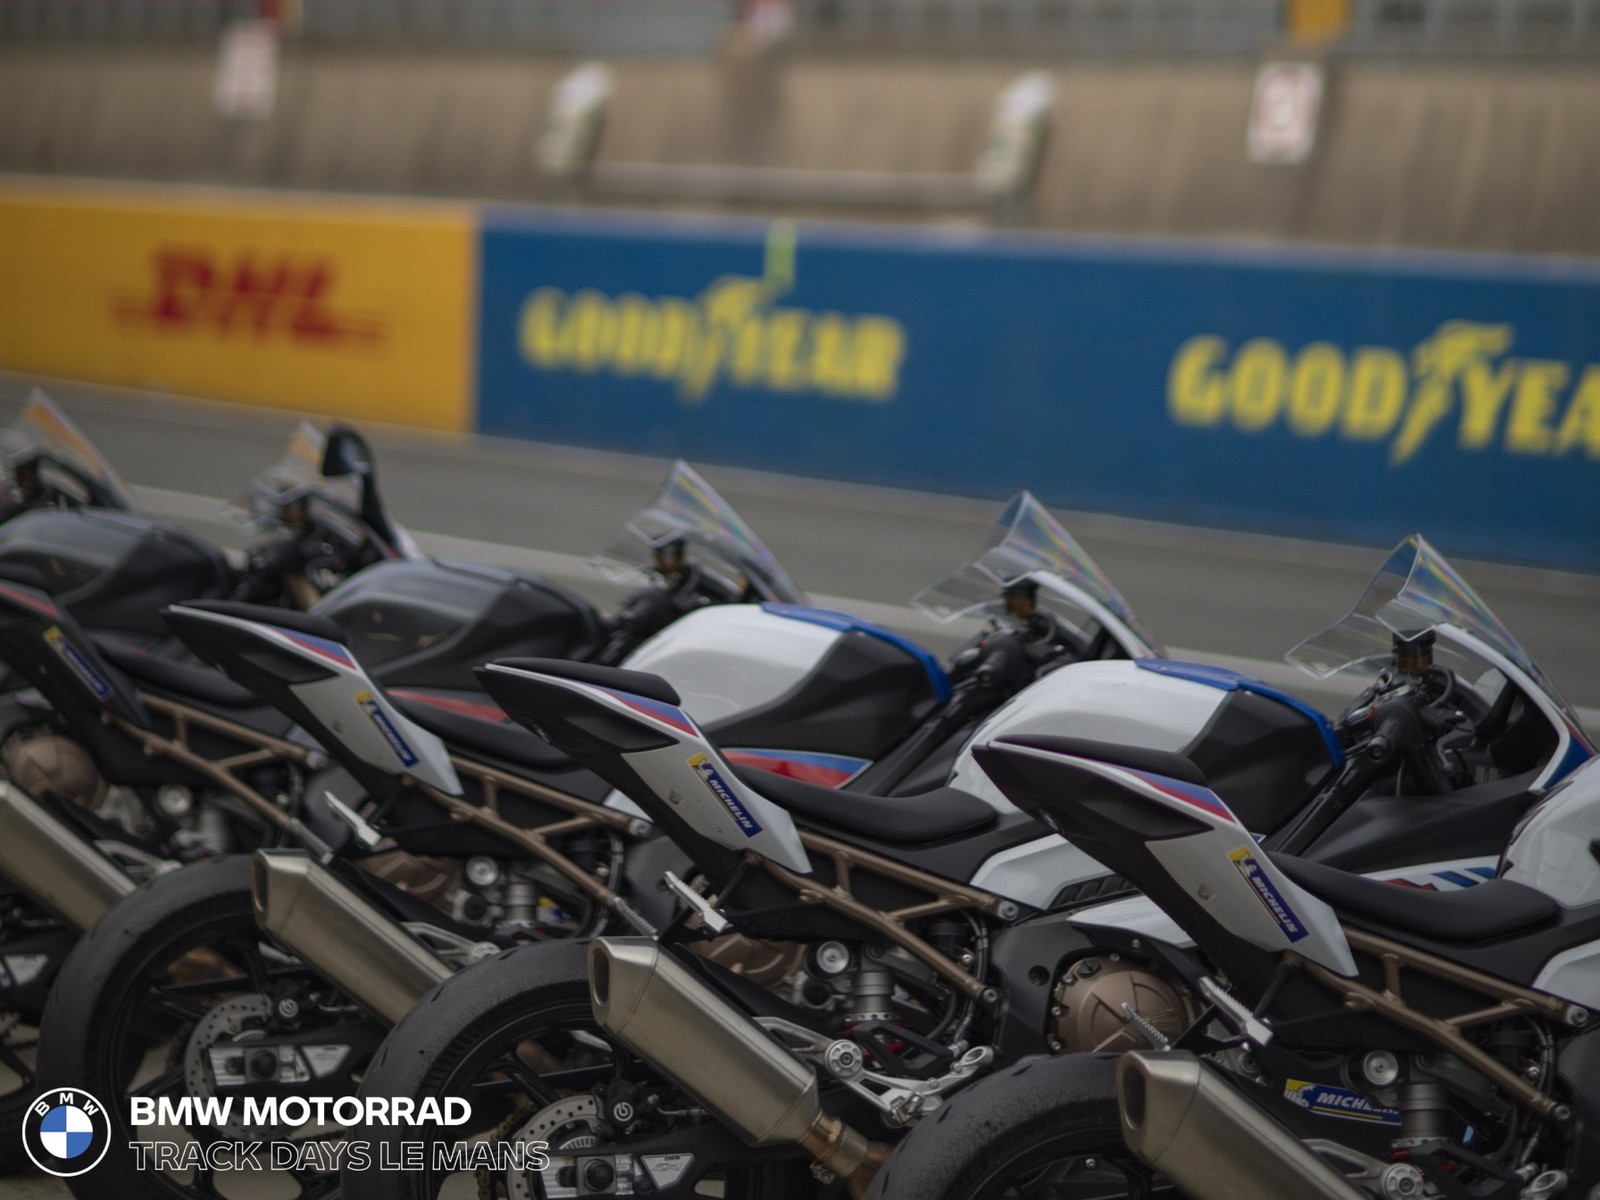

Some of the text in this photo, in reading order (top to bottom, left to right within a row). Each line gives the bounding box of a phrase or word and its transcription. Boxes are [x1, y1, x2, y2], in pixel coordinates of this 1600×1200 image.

[140, 243, 355, 347] DHL
[518, 274, 907, 404] GOODYEAR
[709, 779, 753, 829] MICHELIN
[1251, 876, 1299, 933] MICHELIN
